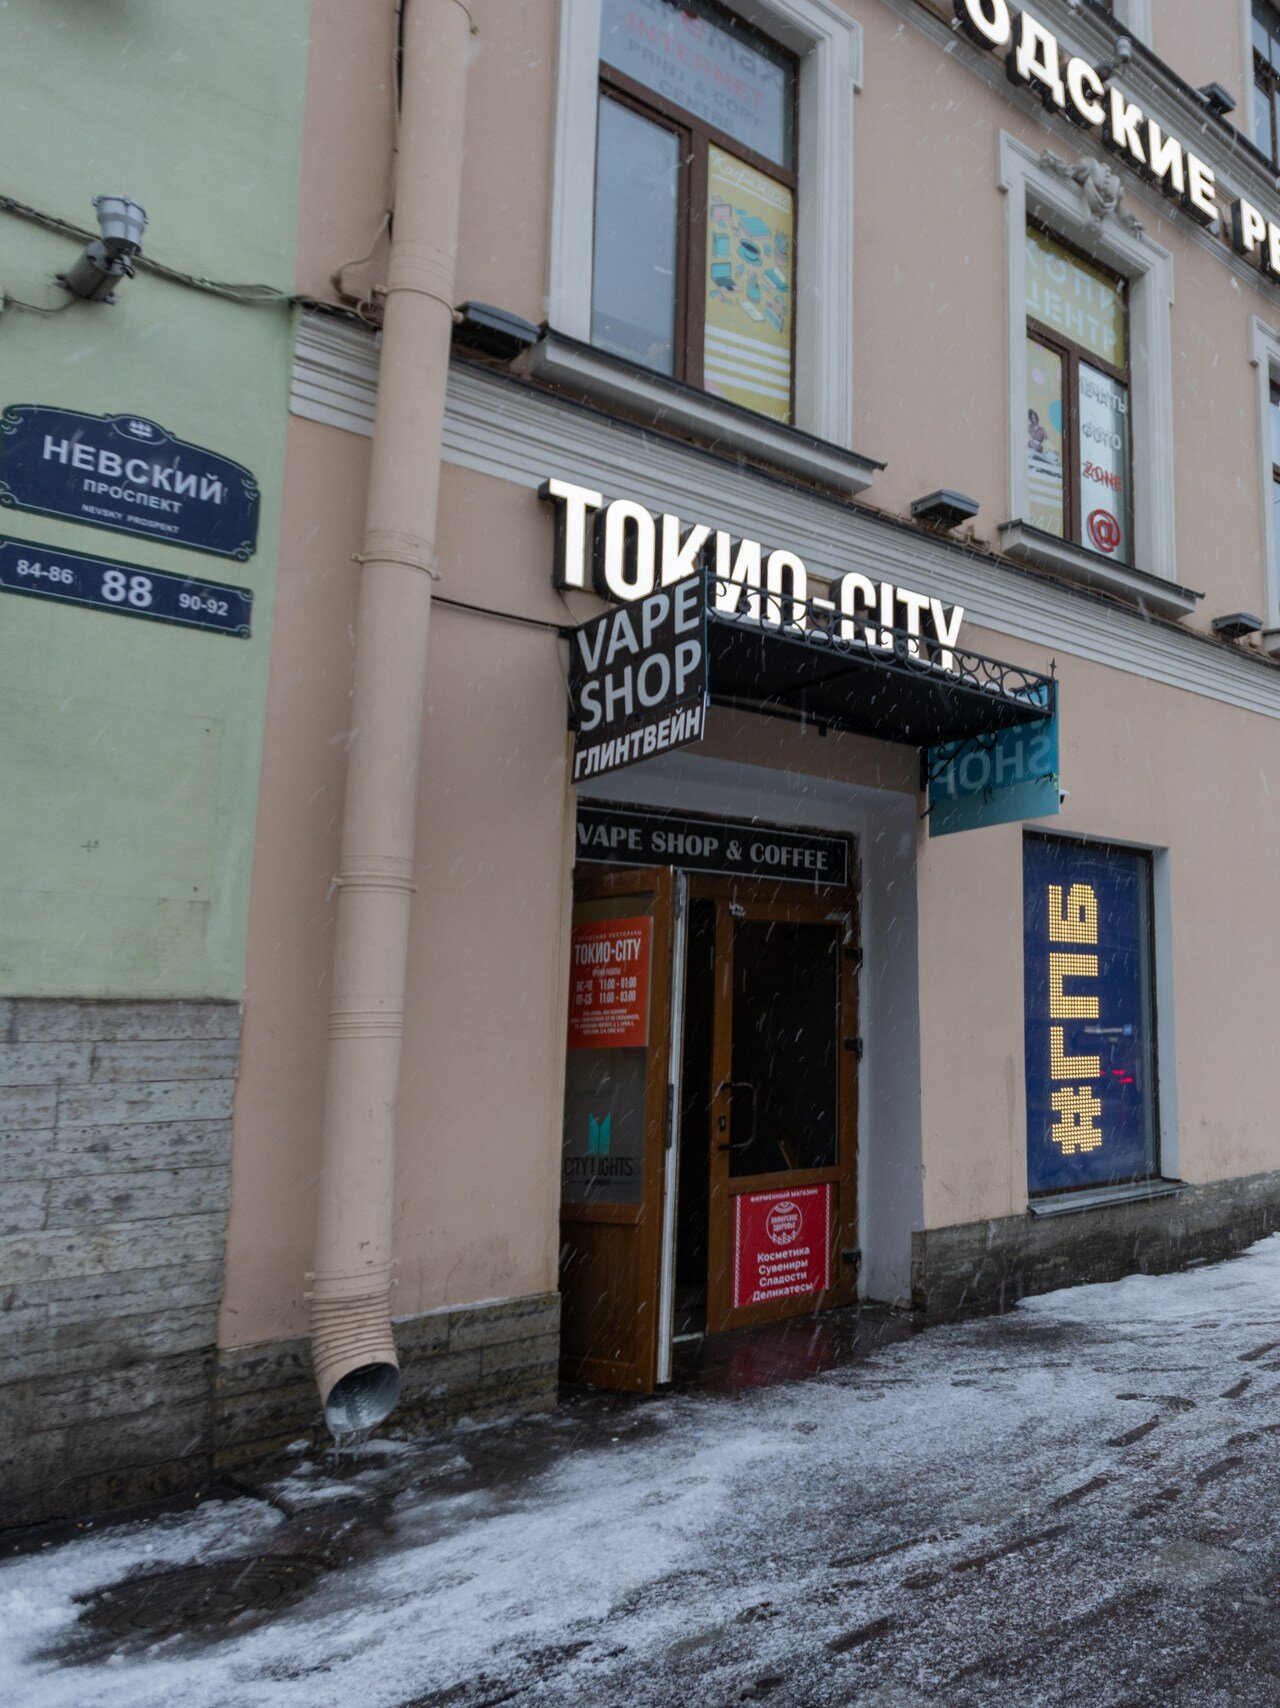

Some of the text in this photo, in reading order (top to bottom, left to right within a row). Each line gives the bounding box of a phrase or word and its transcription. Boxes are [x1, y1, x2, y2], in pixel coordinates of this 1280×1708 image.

[626, 12, 765, 110] INTERNET
[628, 38, 685, 83] PRINT
[713, 91, 764, 127] COPY
[660, 79, 736, 132] CENTRE
[1082, 421, 1122, 450] ФОТО
[42, 435, 223, 504] НЕВСКИЙ
[1083, 460, 1122, 493] ZONE
[83, 478, 182, 514] ПРОСПЕКТ
[81, 503, 179, 534] NEVSKY PROSPEKT
[16, 559, 229, 617] 84-86 88 90-92
[577, 576, 700, 674] VAPE
[580, 639, 701, 732] SHOP
[574, 706, 700, 779] ГЛИНТВЕЙН
[577, 822, 828, 871] VAPE SHOP & COFFEE
[575, 938, 641, 965] ТОКИО-CITY
[565, 1156, 633, 1177] CITY LIGHTS
[750, 1188, 818, 1203] ФИРМЕННЫЙ МАГАЗИН
[757, 1246, 810, 1263] Косметика
[758, 1259, 808, 1276] Сувениры
[752, 1282, 813, 1303] Деликатесы
[758, 1271, 807, 1288] Сладости
